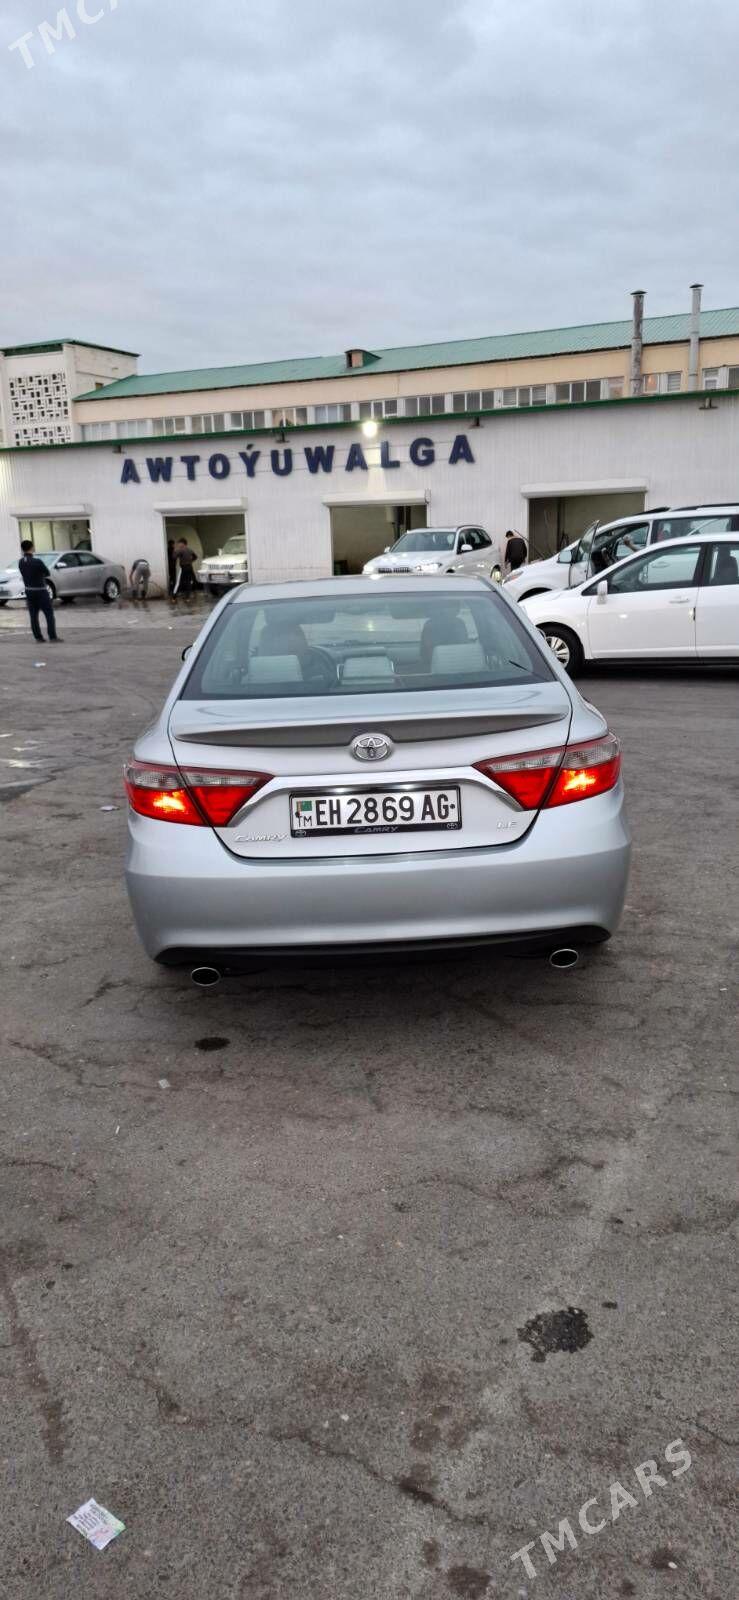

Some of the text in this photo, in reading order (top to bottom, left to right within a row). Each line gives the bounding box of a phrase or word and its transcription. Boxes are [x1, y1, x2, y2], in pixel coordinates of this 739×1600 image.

[120, 434, 475, 485] AWTOÝUWALGA
[315, 793, 450, 826] EH 2869 AG
